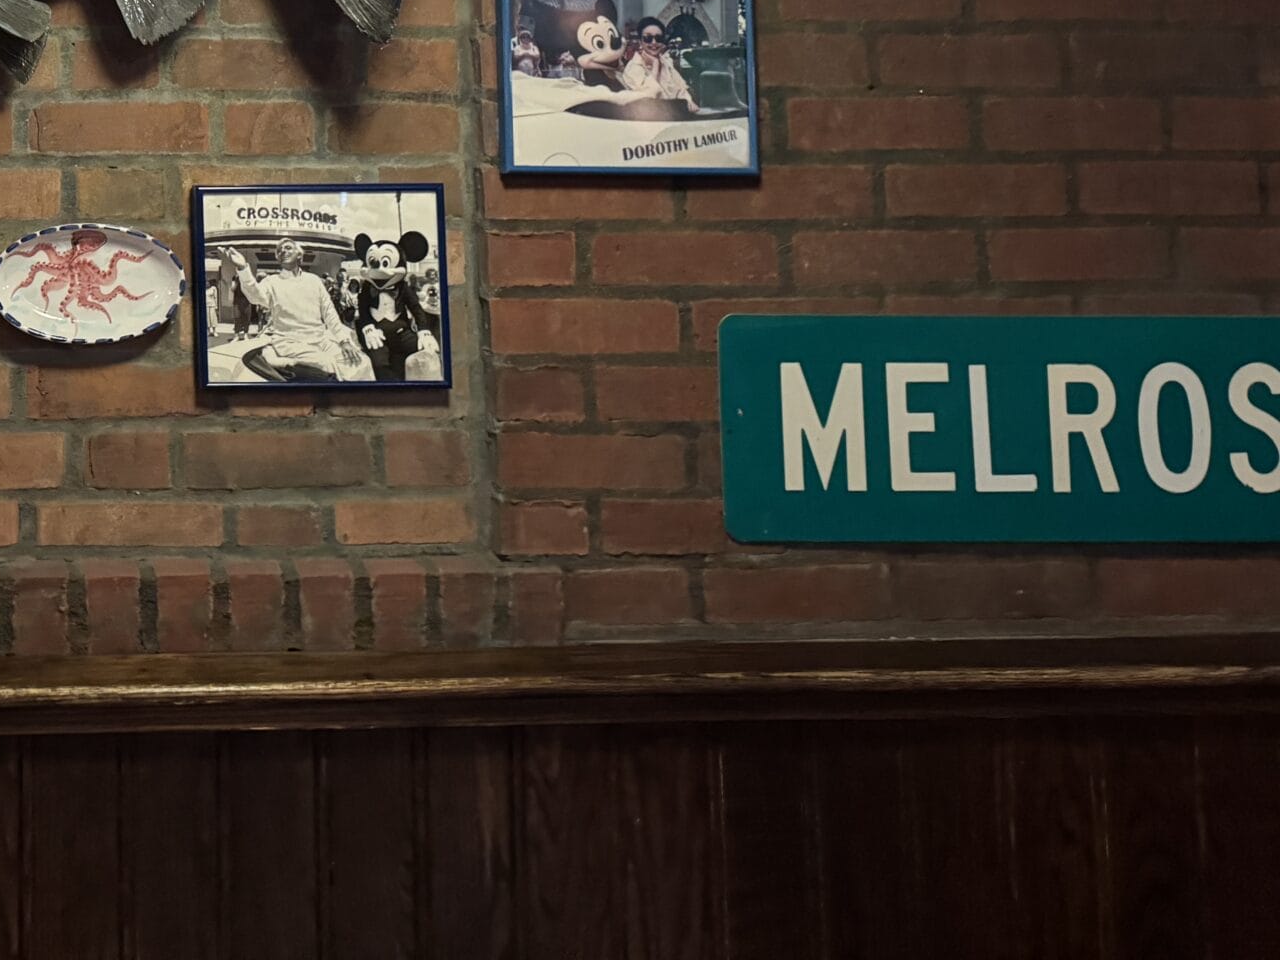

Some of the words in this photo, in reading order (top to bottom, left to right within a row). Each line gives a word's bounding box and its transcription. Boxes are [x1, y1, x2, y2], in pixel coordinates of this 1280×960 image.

[622, 138, 689, 161] DOROTHY
[693, 129, 738, 148] LAMOUR
[237, 207, 337, 225] CROSSROADS
[780, 361, 1280, 494] MELROS
